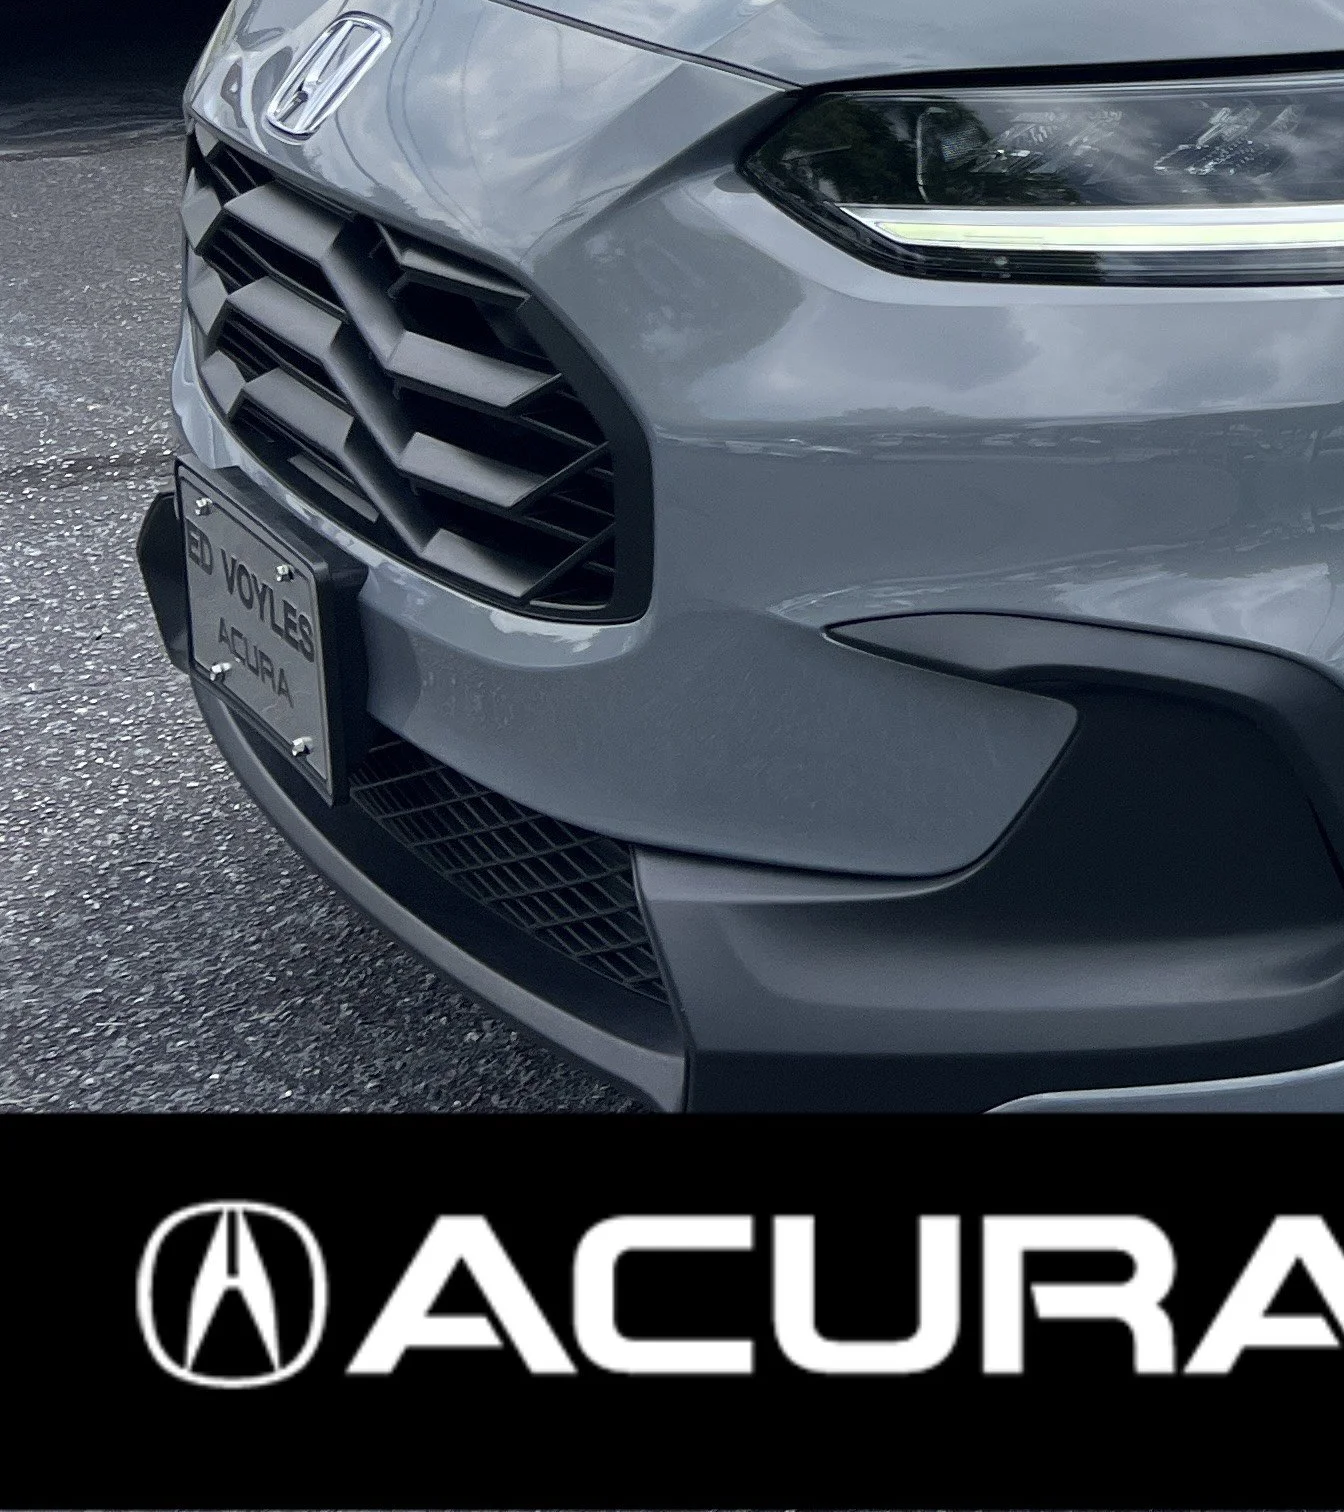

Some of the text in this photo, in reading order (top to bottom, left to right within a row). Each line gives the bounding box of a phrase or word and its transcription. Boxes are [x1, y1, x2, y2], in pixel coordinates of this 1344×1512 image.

[186, 519, 315, 663] ED VOYLES
[217, 617, 294, 709] ACURA
